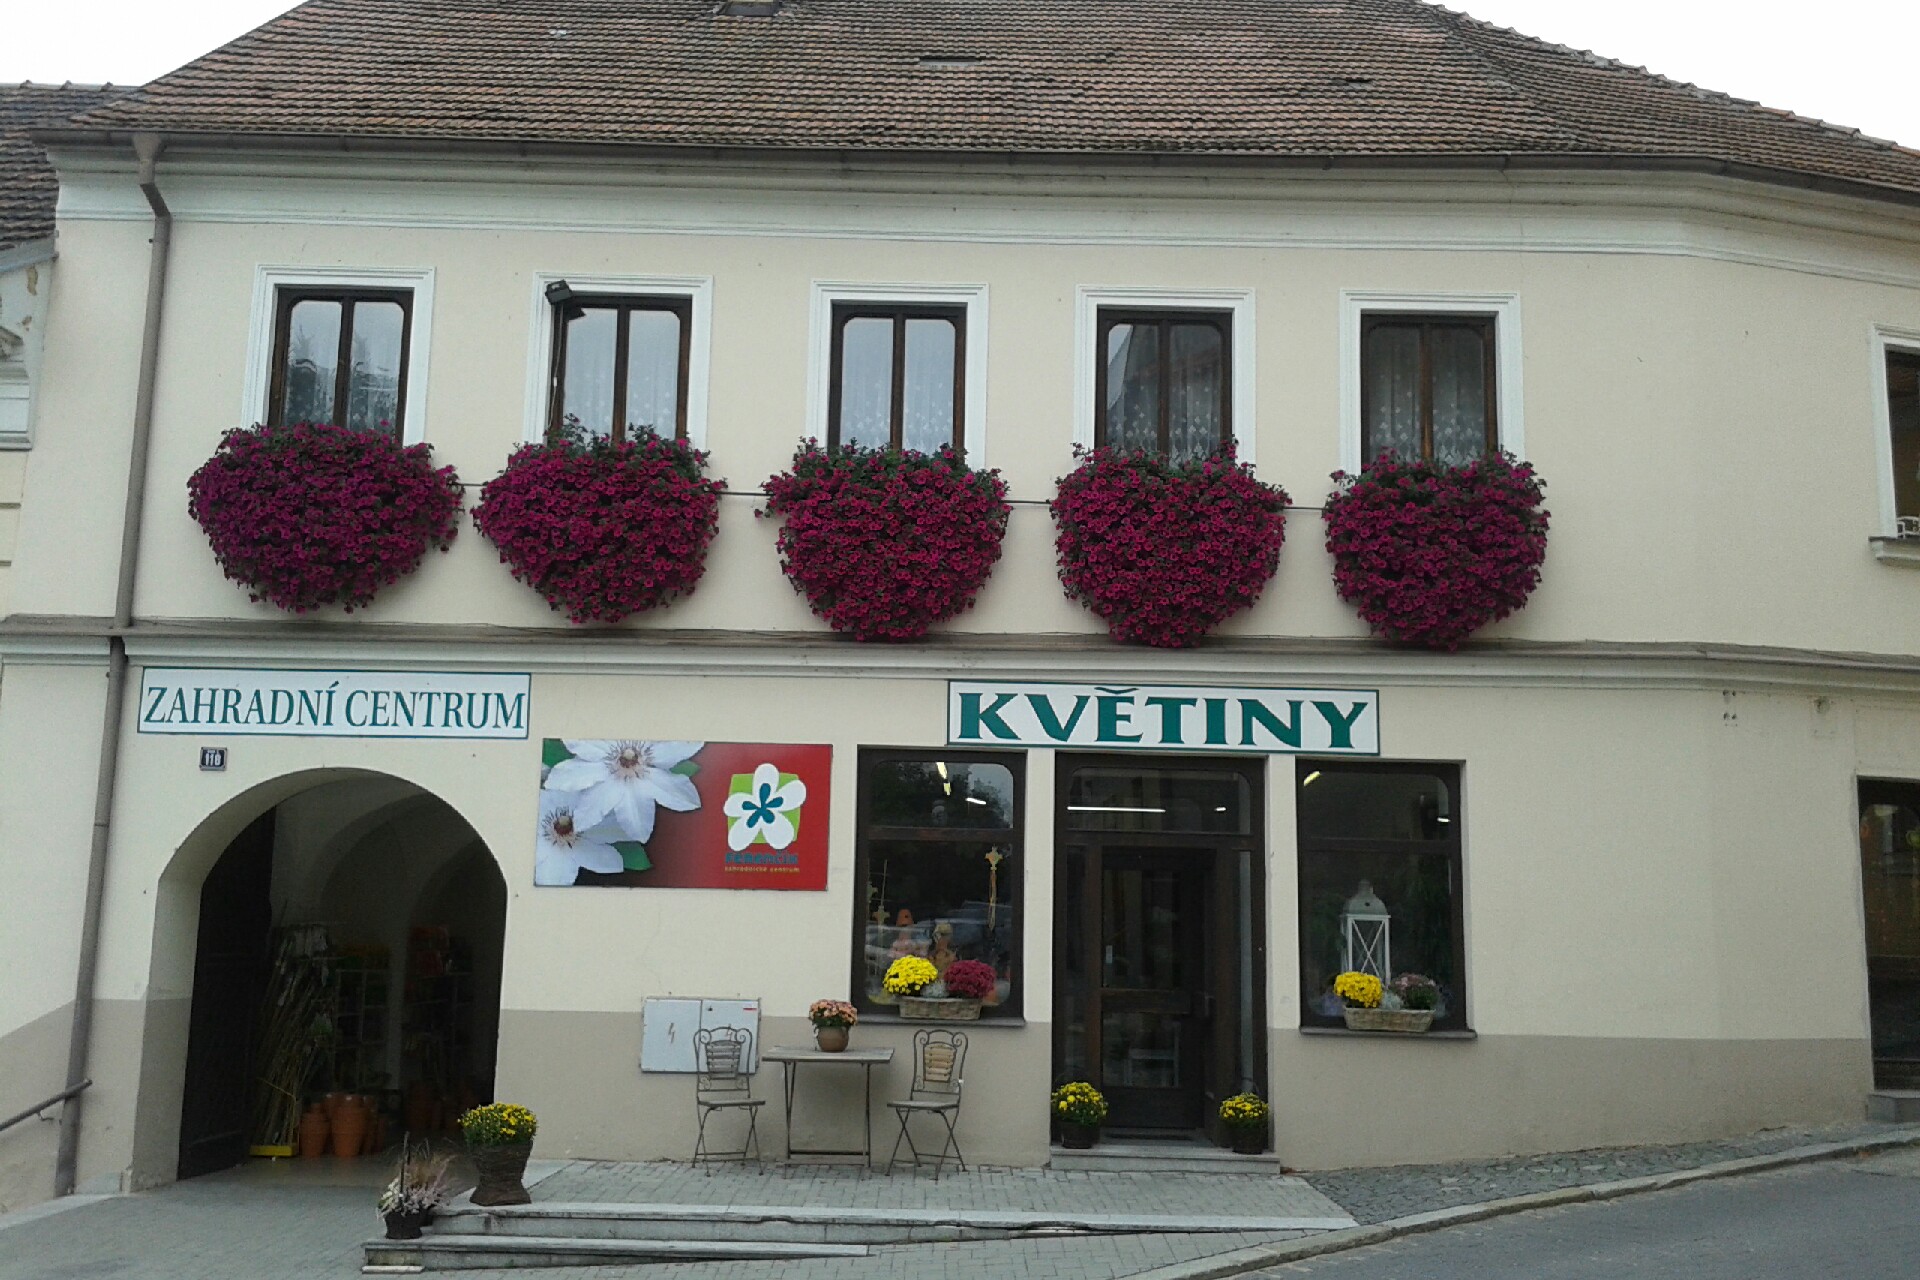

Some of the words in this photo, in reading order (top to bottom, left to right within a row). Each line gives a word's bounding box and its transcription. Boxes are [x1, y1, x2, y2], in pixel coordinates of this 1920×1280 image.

[143, 681, 339, 726] ZAHRADNÍ
[345, 689, 525, 729] CENTRUM
[957, 686, 1369, 749] KVĚTINY
